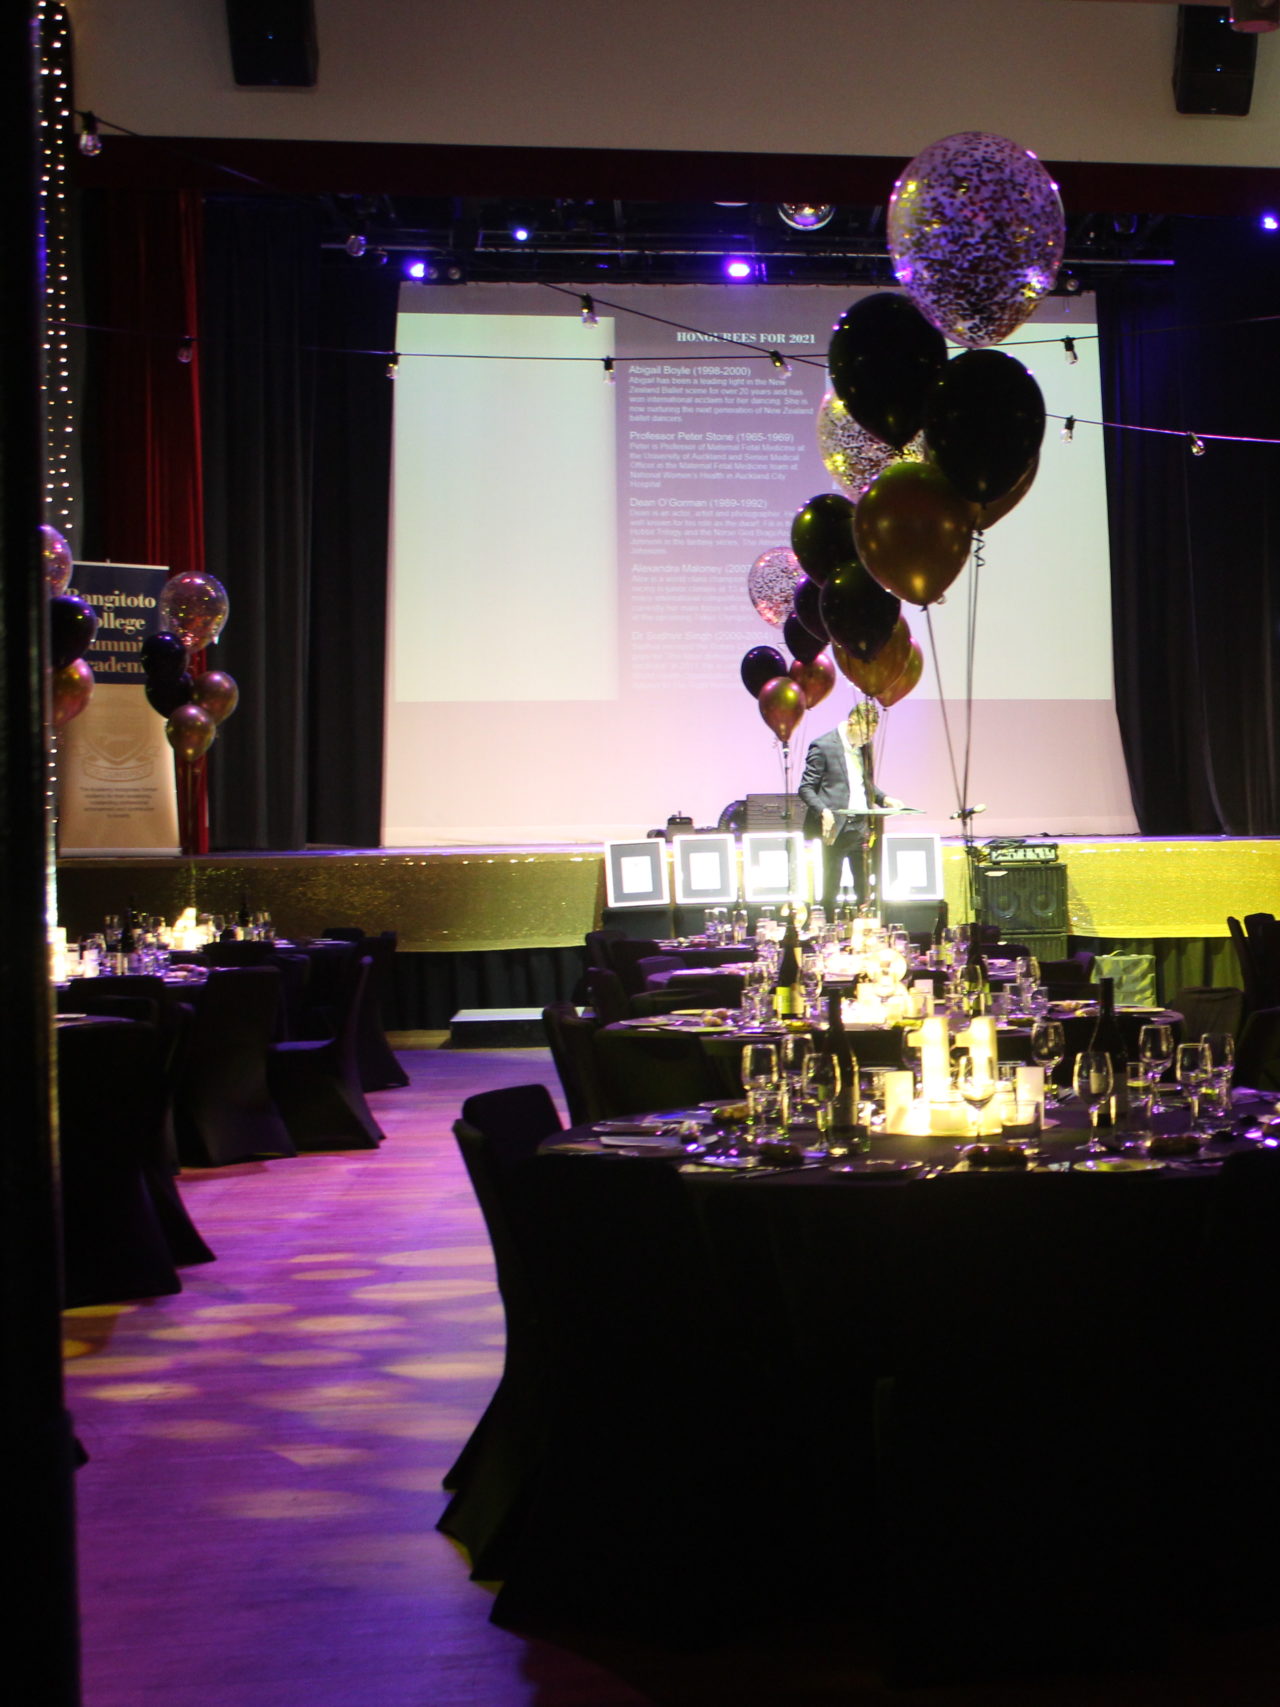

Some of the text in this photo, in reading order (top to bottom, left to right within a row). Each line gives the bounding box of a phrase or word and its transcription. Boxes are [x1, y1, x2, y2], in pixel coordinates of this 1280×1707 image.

[760, 333, 786, 344] FOR
[788, 333, 817, 345] 2021
[629, 365, 662, 377] Abigail
[663, 365, 691, 377] Boyle
[629, 431, 676, 441] Professor
[677, 431, 703, 441] Peter
[704, 432, 735, 442] Stone
[629, 498, 657, 507] Dean
[95, 611, 147, 635] ollege
[88, 635, 144, 653] ummi
[908, 1015, 998, 1132] 11
